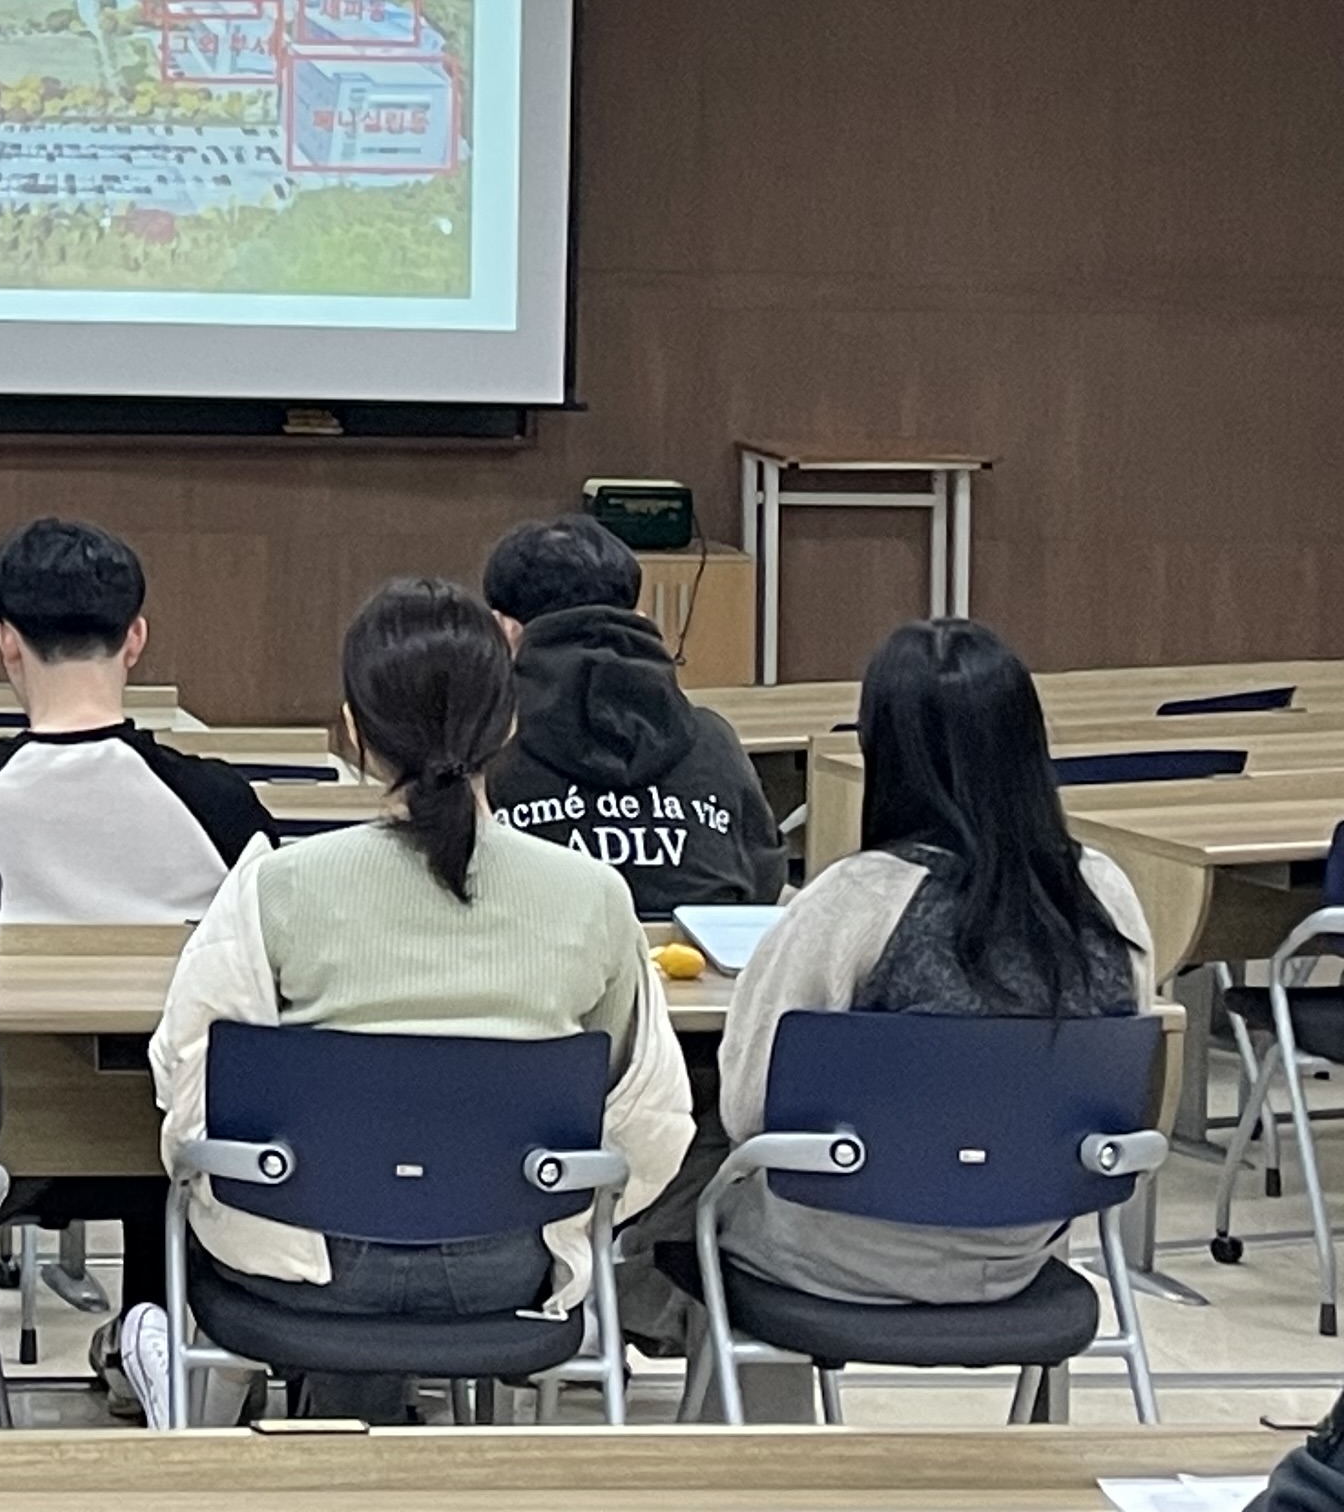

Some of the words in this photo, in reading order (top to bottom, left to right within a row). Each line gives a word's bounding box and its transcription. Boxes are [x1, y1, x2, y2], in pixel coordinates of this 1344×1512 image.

[494, 785, 587, 828] acmé
[597, 791, 641, 819] de
[647, 785, 686, 820] la
[691, 794, 731, 835] vie
[568, 825, 688, 866] ADLV
